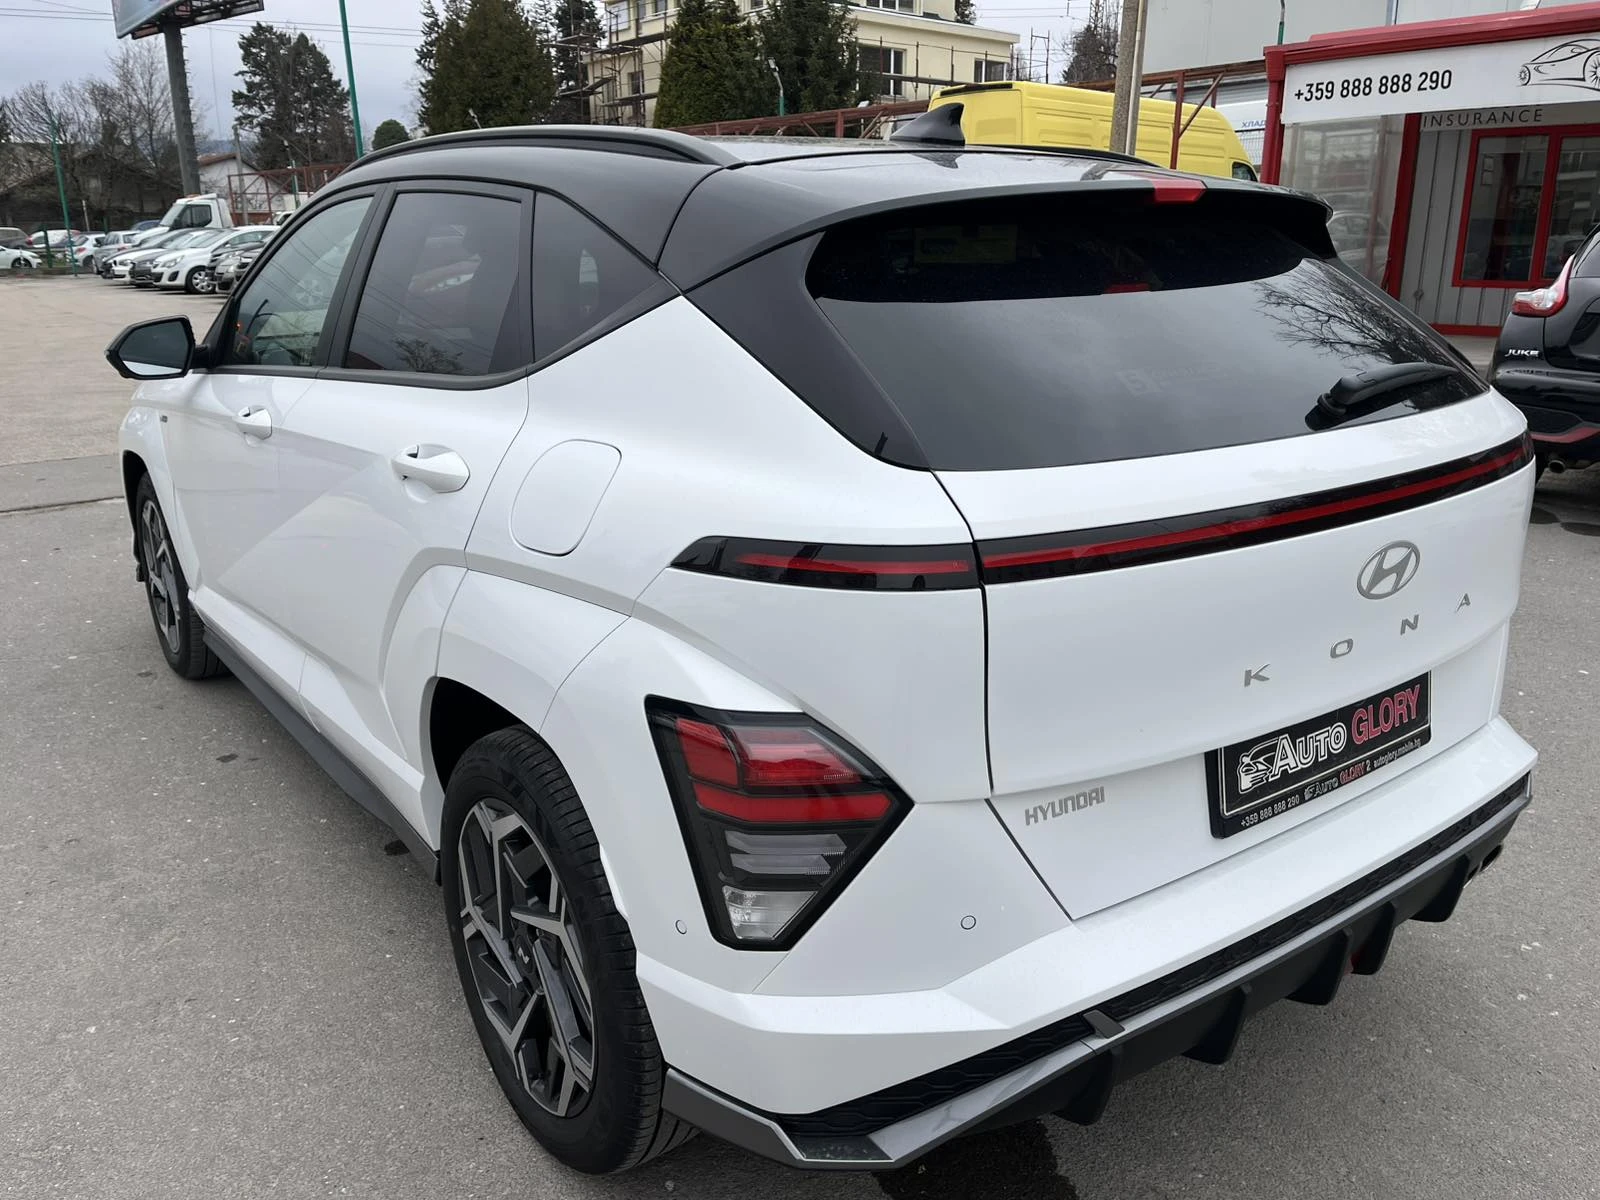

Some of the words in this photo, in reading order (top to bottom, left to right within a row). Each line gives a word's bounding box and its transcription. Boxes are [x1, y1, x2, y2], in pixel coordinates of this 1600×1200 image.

[1294, 81, 1335, 102] +359
[1340, 77, 1373, 98] 888
[1378, 73, 1412, 95] 888
[1417, 69, 1453, 91] 290
[1423, 108, 1543, 128] INSURANCE
[1504, 348, 1540, 358] JUKE
[1351, 684, 1421, 745] GLORY
[1024, 785, 1106, 827] HYUNDAI
[1240, 812, 1259, 828] +359
[1260, 806, 1273, 821] 888
[1273, 800, 1287, 814] 888
[1287, 794, 1300, 808] 290
[1339, 761, 1366, 785] GLORY
[1366, 759, 1371, 772] 2
